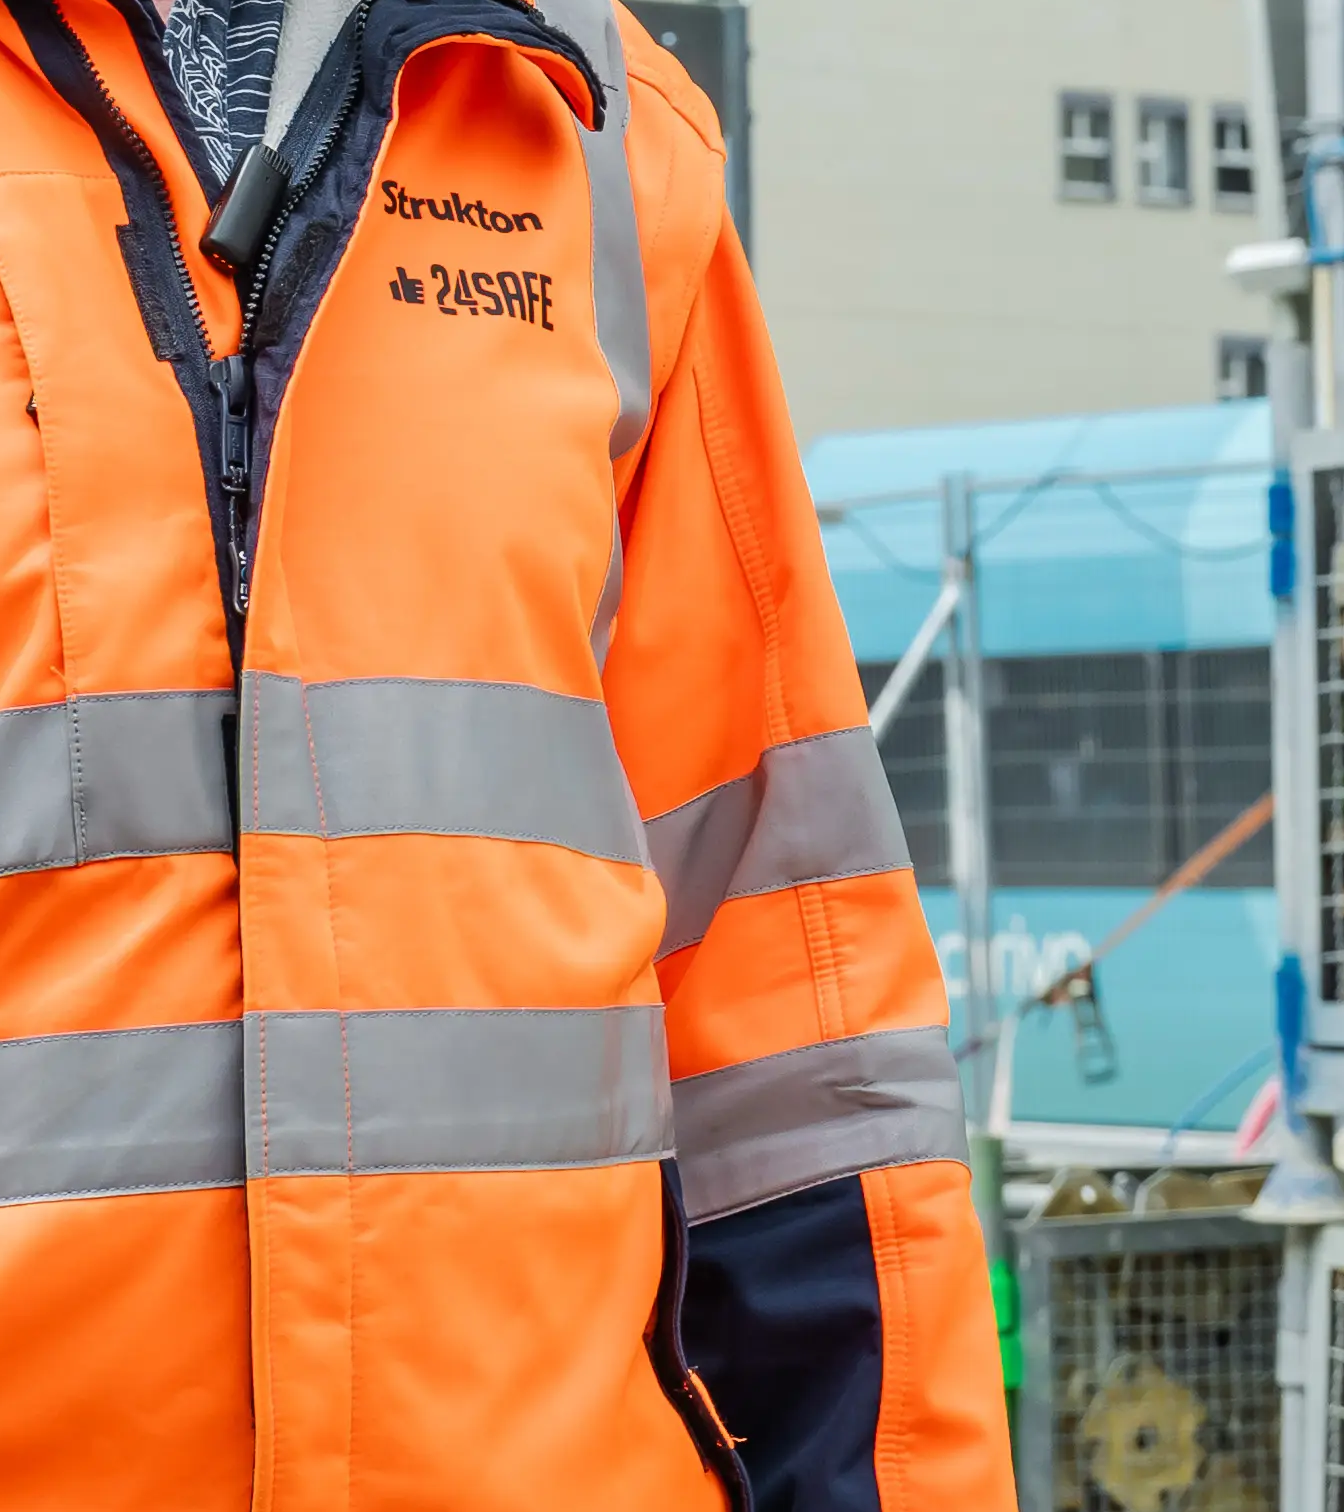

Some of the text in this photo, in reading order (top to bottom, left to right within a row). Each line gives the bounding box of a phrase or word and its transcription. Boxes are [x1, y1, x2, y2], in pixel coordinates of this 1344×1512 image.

[381, 179, 544, 234] Strukton
[430, 263, 555, 332] 24SAFE
[934, 913, 1093, 997] ariva
